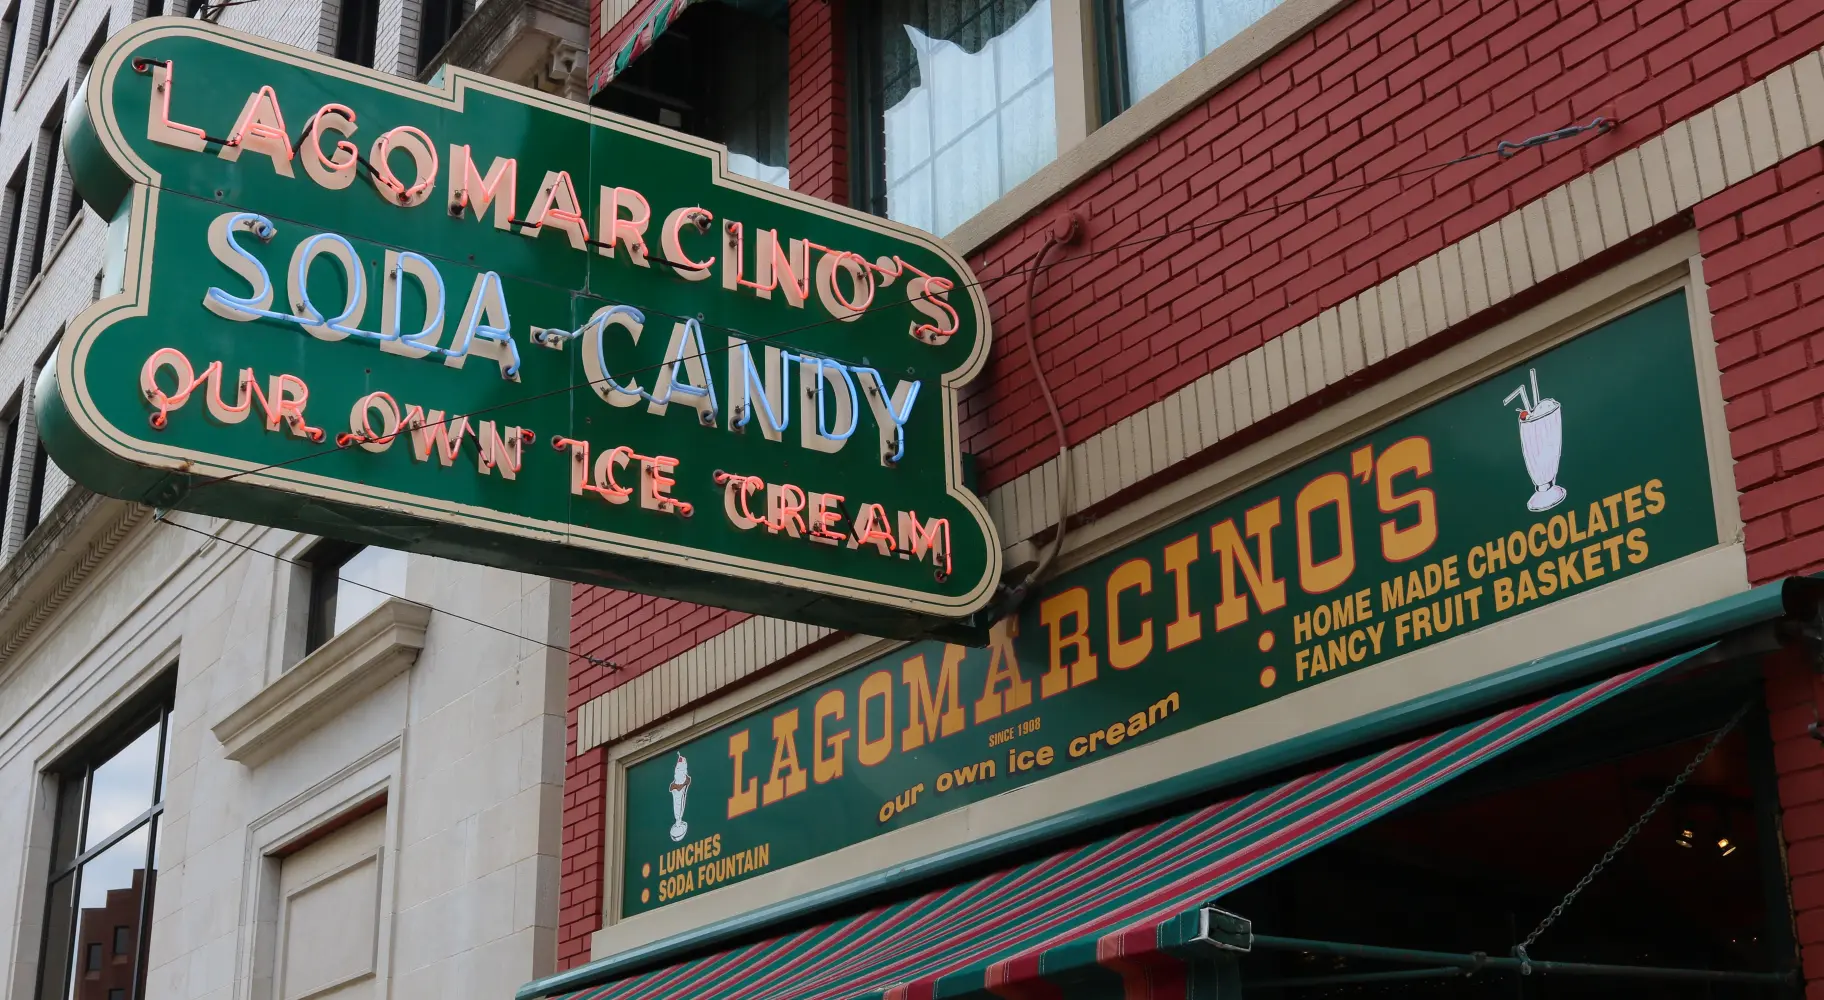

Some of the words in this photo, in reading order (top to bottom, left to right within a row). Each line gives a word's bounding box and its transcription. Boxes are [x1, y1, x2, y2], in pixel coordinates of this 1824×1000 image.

[147, 60, 959, 346] LAGOMARCINO'S
[140, 347, 318, 439] OUR
[347, 391, 526, 480] OWN
[567, 440, 683, 514] ICE
[722, 474, 951, 573] CREAM
[726, 435, 1439, 821] LAGOMARCINO'S
[1293, 588, 1373, 646] HOME
[1380, 554, 1461, 613] MADE
[1466, 478, 1666, 580] CHOCOLATES
[1295, 621, 1386, 682] FANCY
[1395, 586, 1483, 647] FRUIT
[1493, 527, 1650, 612] BASKETS
[878, 782, 925, 825] our
[936, 758, 997, 794] own
[1008, 746, 1054, 773] ice
[1068, 690, 1181, 758] cream
[988, 726, 1015, 748] SINCE
[1017, 716, 1041, 738] 1908
[658, 834, 721, 877] LUNCHES
[658, 870, 694, 902] SODA
[698, 843, 769, 890] FOUNTAIN
